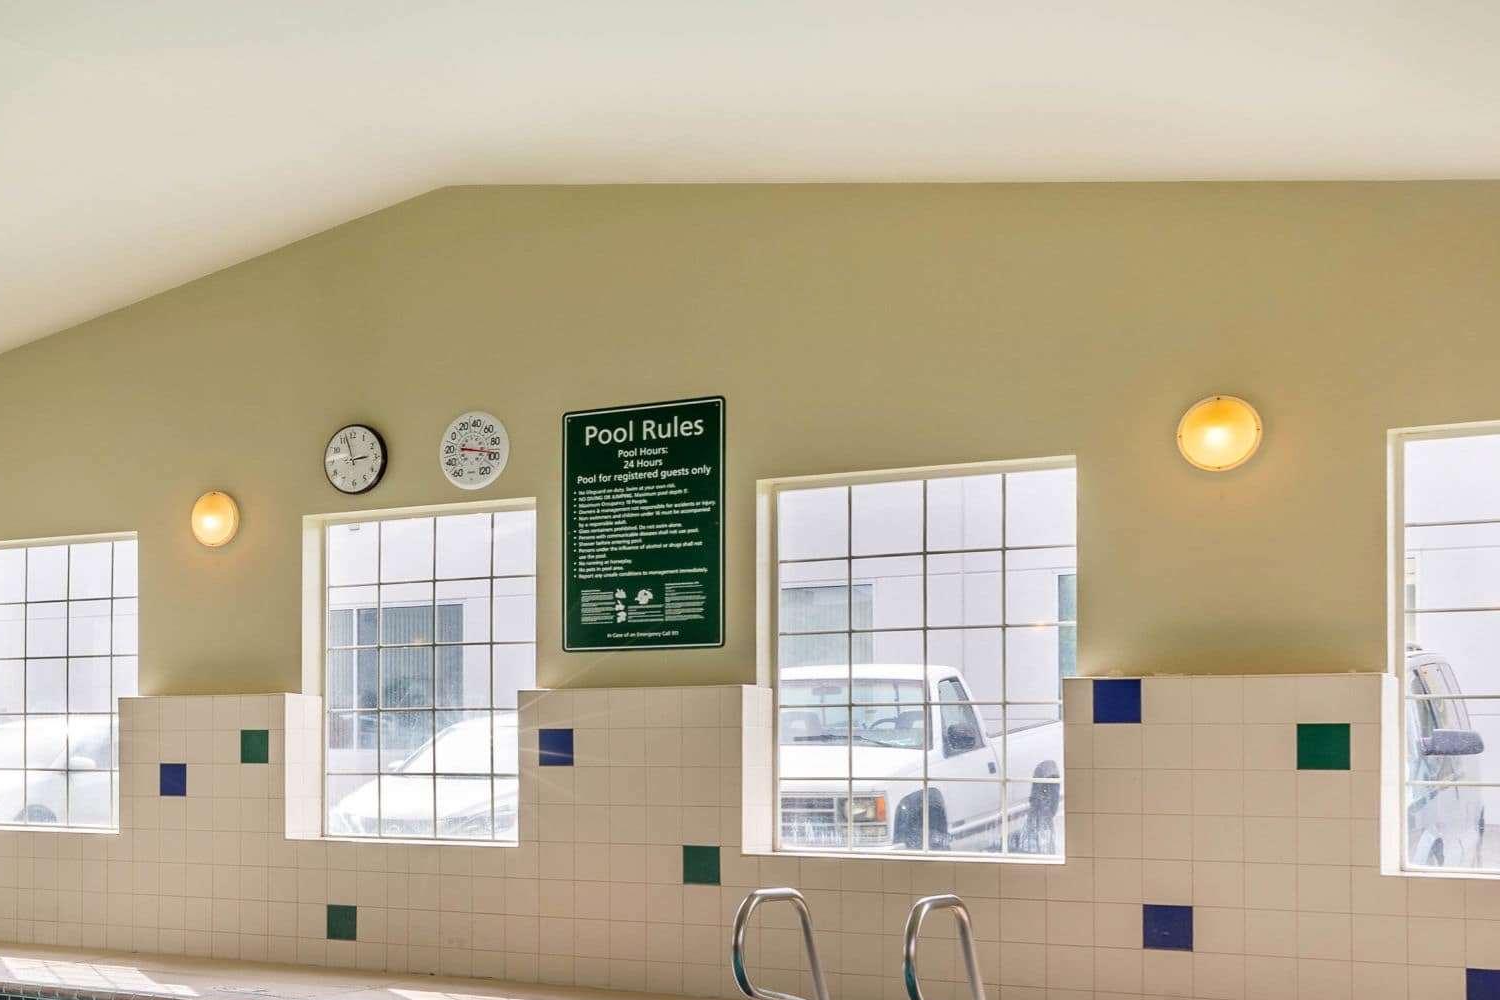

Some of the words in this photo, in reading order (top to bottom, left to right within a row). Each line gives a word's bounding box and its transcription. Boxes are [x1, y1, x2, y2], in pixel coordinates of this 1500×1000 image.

[458, 422, 468, 431] 20
[472, 419, 482, 428] 40
[484, 424, 494, 434] 60
[585, 420, 633, 446] Pool
[643, 416, 704, 440] Rules
[451, 432, 456, 440] 0
[490, 437, 500, 446] 80
[618, 448, 637, 458] Pool
[639, 446, 668, 456] Hours:
[623, 460, 634, 469] 24
[636, 458, 663, 468] Hours
[577, 475, 596, 484] Pool
[599, 473, 611, 482] for
[614, 470, 658, 482] registered
[660, 468, 689, 478] guests
[692, 465, 712, 476] only
